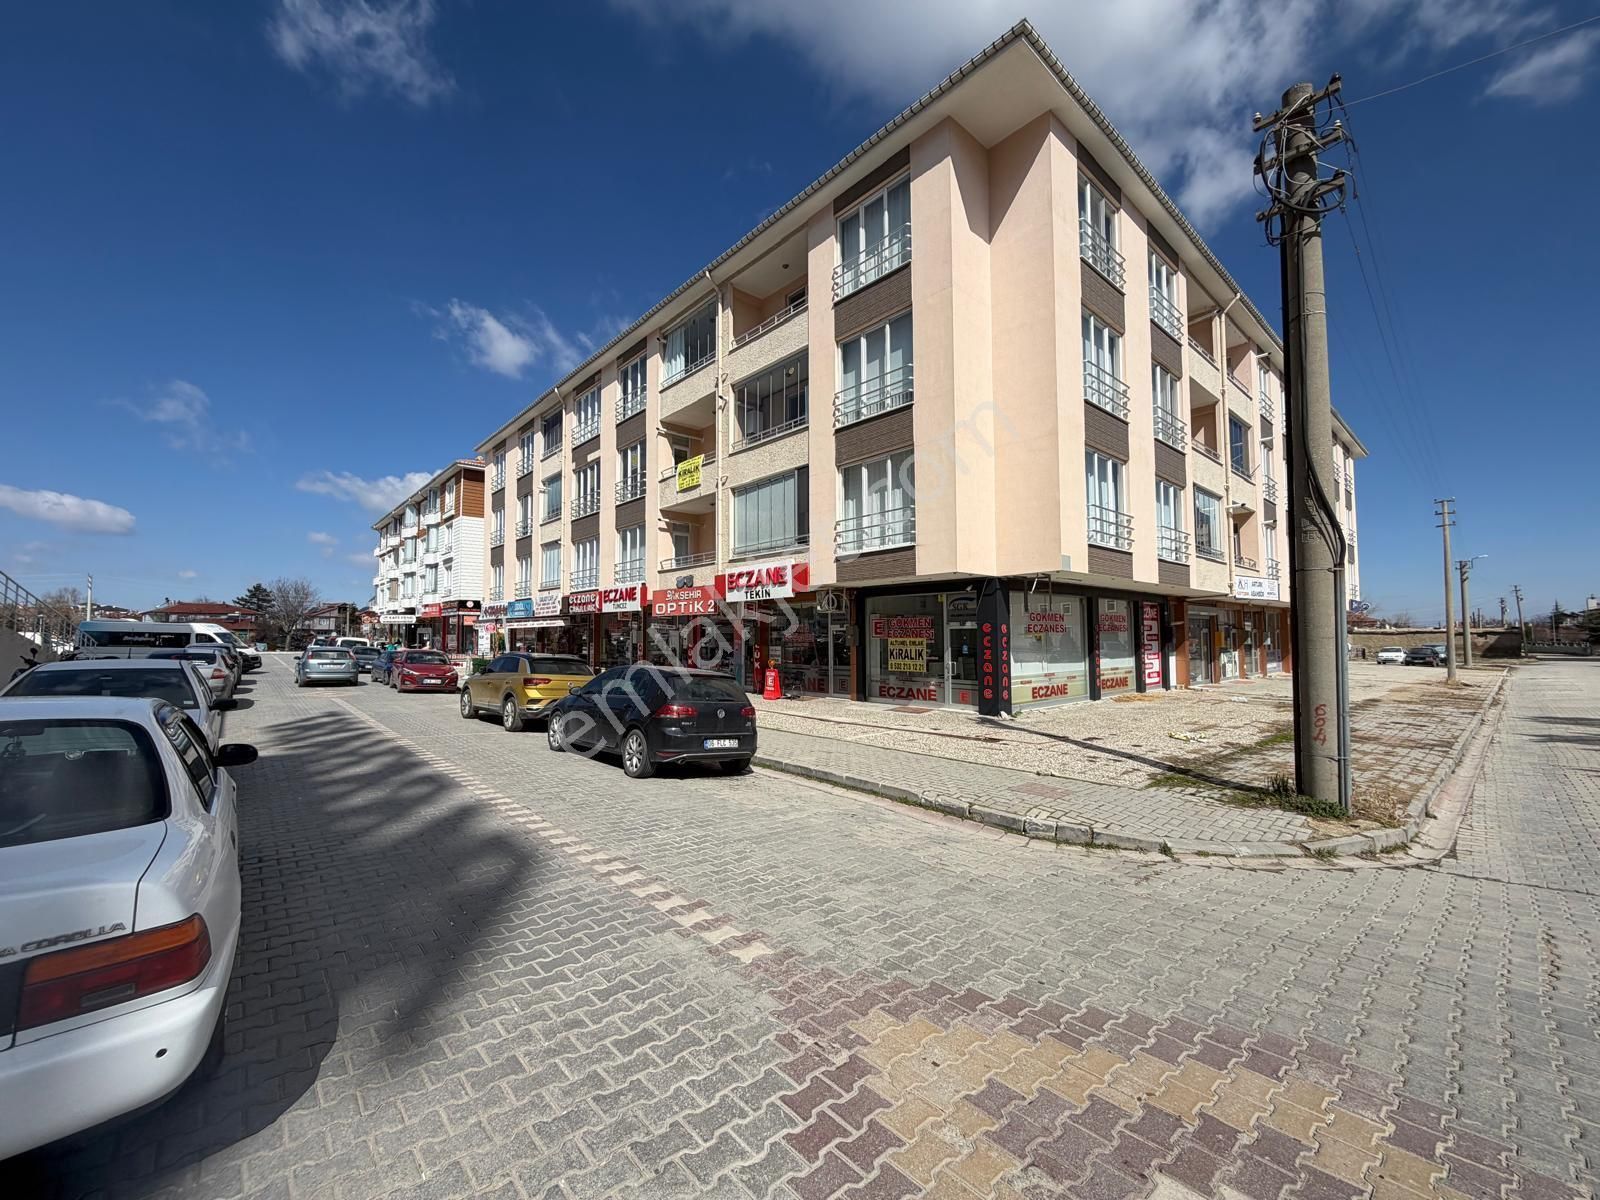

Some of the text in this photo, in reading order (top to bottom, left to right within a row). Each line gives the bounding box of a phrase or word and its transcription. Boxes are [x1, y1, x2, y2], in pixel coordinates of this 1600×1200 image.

[727, 565, 788, 591] ECZANE
[569, 593, 595, 604] eczane
[603, 587, 636, 603] ECZANE
[707, 599, 715, 612] 2
[874, 621, 884, 635] E
[982, 622, 993, 700] eczane
[1001, 623, 1009, 700] eczane
[1101, 676, 1129, 689] ECZANE
[879, 686, 937, 701] ECZANE
[1032, 684, 1068, 699] ECZANE
[21, 922, 126, 952] COROLLA
